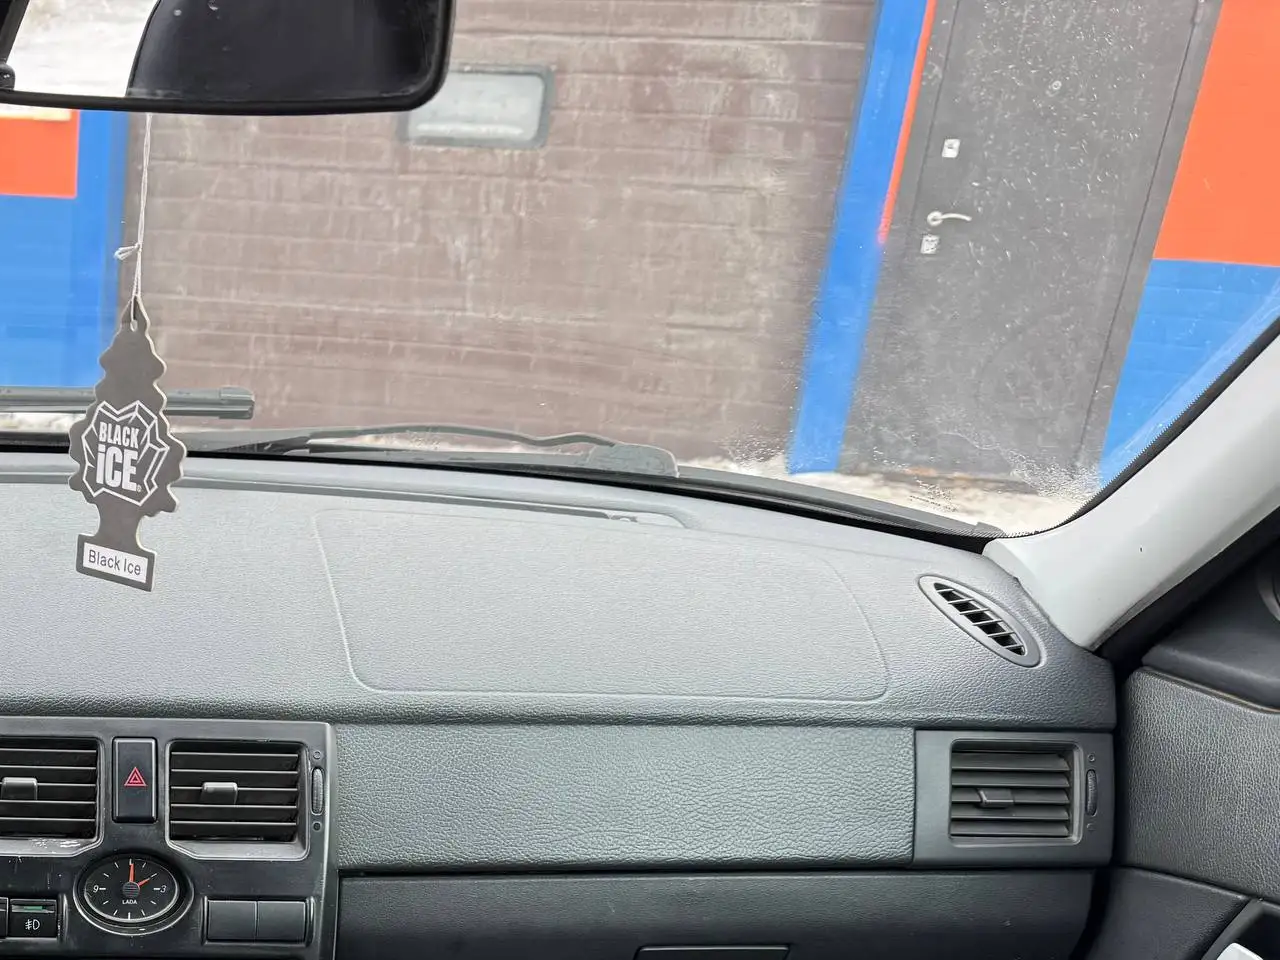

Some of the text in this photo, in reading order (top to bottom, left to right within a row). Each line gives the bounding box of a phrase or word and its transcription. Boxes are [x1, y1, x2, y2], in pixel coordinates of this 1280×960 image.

[98, 421, 140, 448] BLACK
[88, 549, 141, 576] Black Ice
[92, 884, 100, 893] 9
[160, 884, 167, 893] 3
